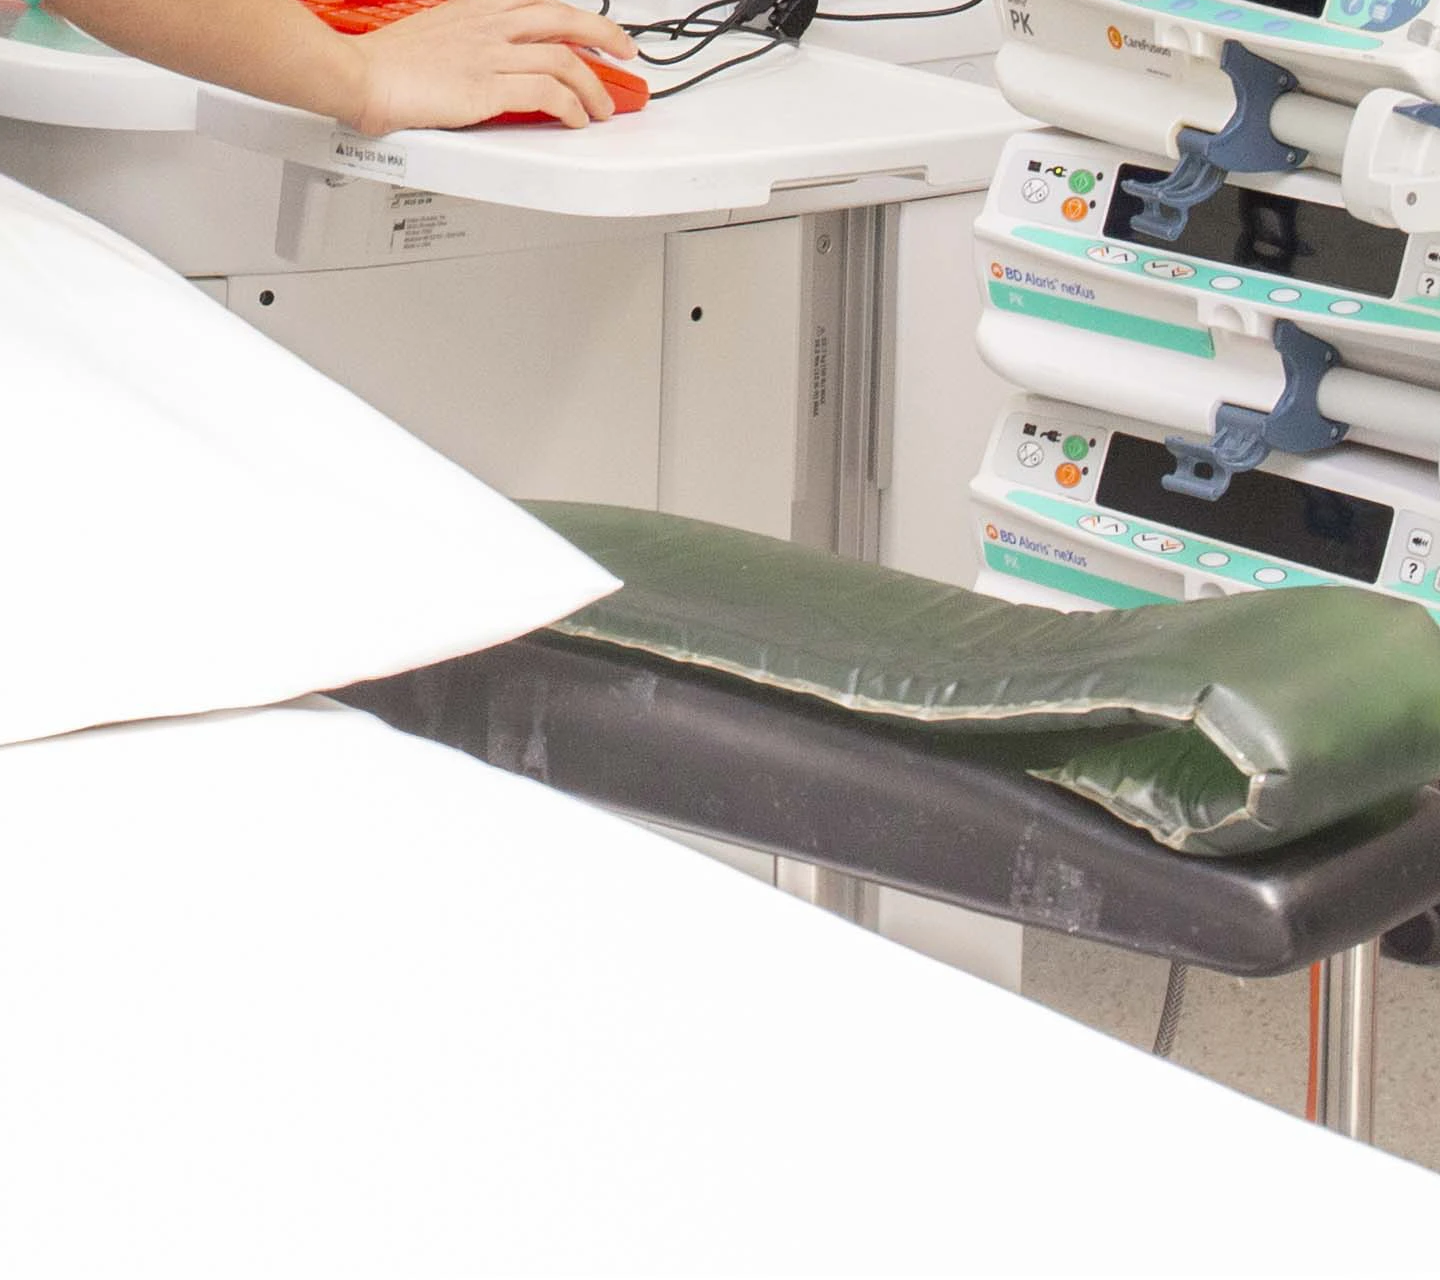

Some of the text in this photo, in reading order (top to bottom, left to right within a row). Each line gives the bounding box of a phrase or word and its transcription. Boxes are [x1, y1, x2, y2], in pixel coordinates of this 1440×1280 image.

[1010, 9, 1034, 36] PK
[1123, 35, 1172, 57] CareFusion
[387, 153, 404, 167] MAX
[1005, 266, 1023, 282] BD
[1061, 282, 1095, 300] neXus
[1000, 529, 1017, 545] BD
